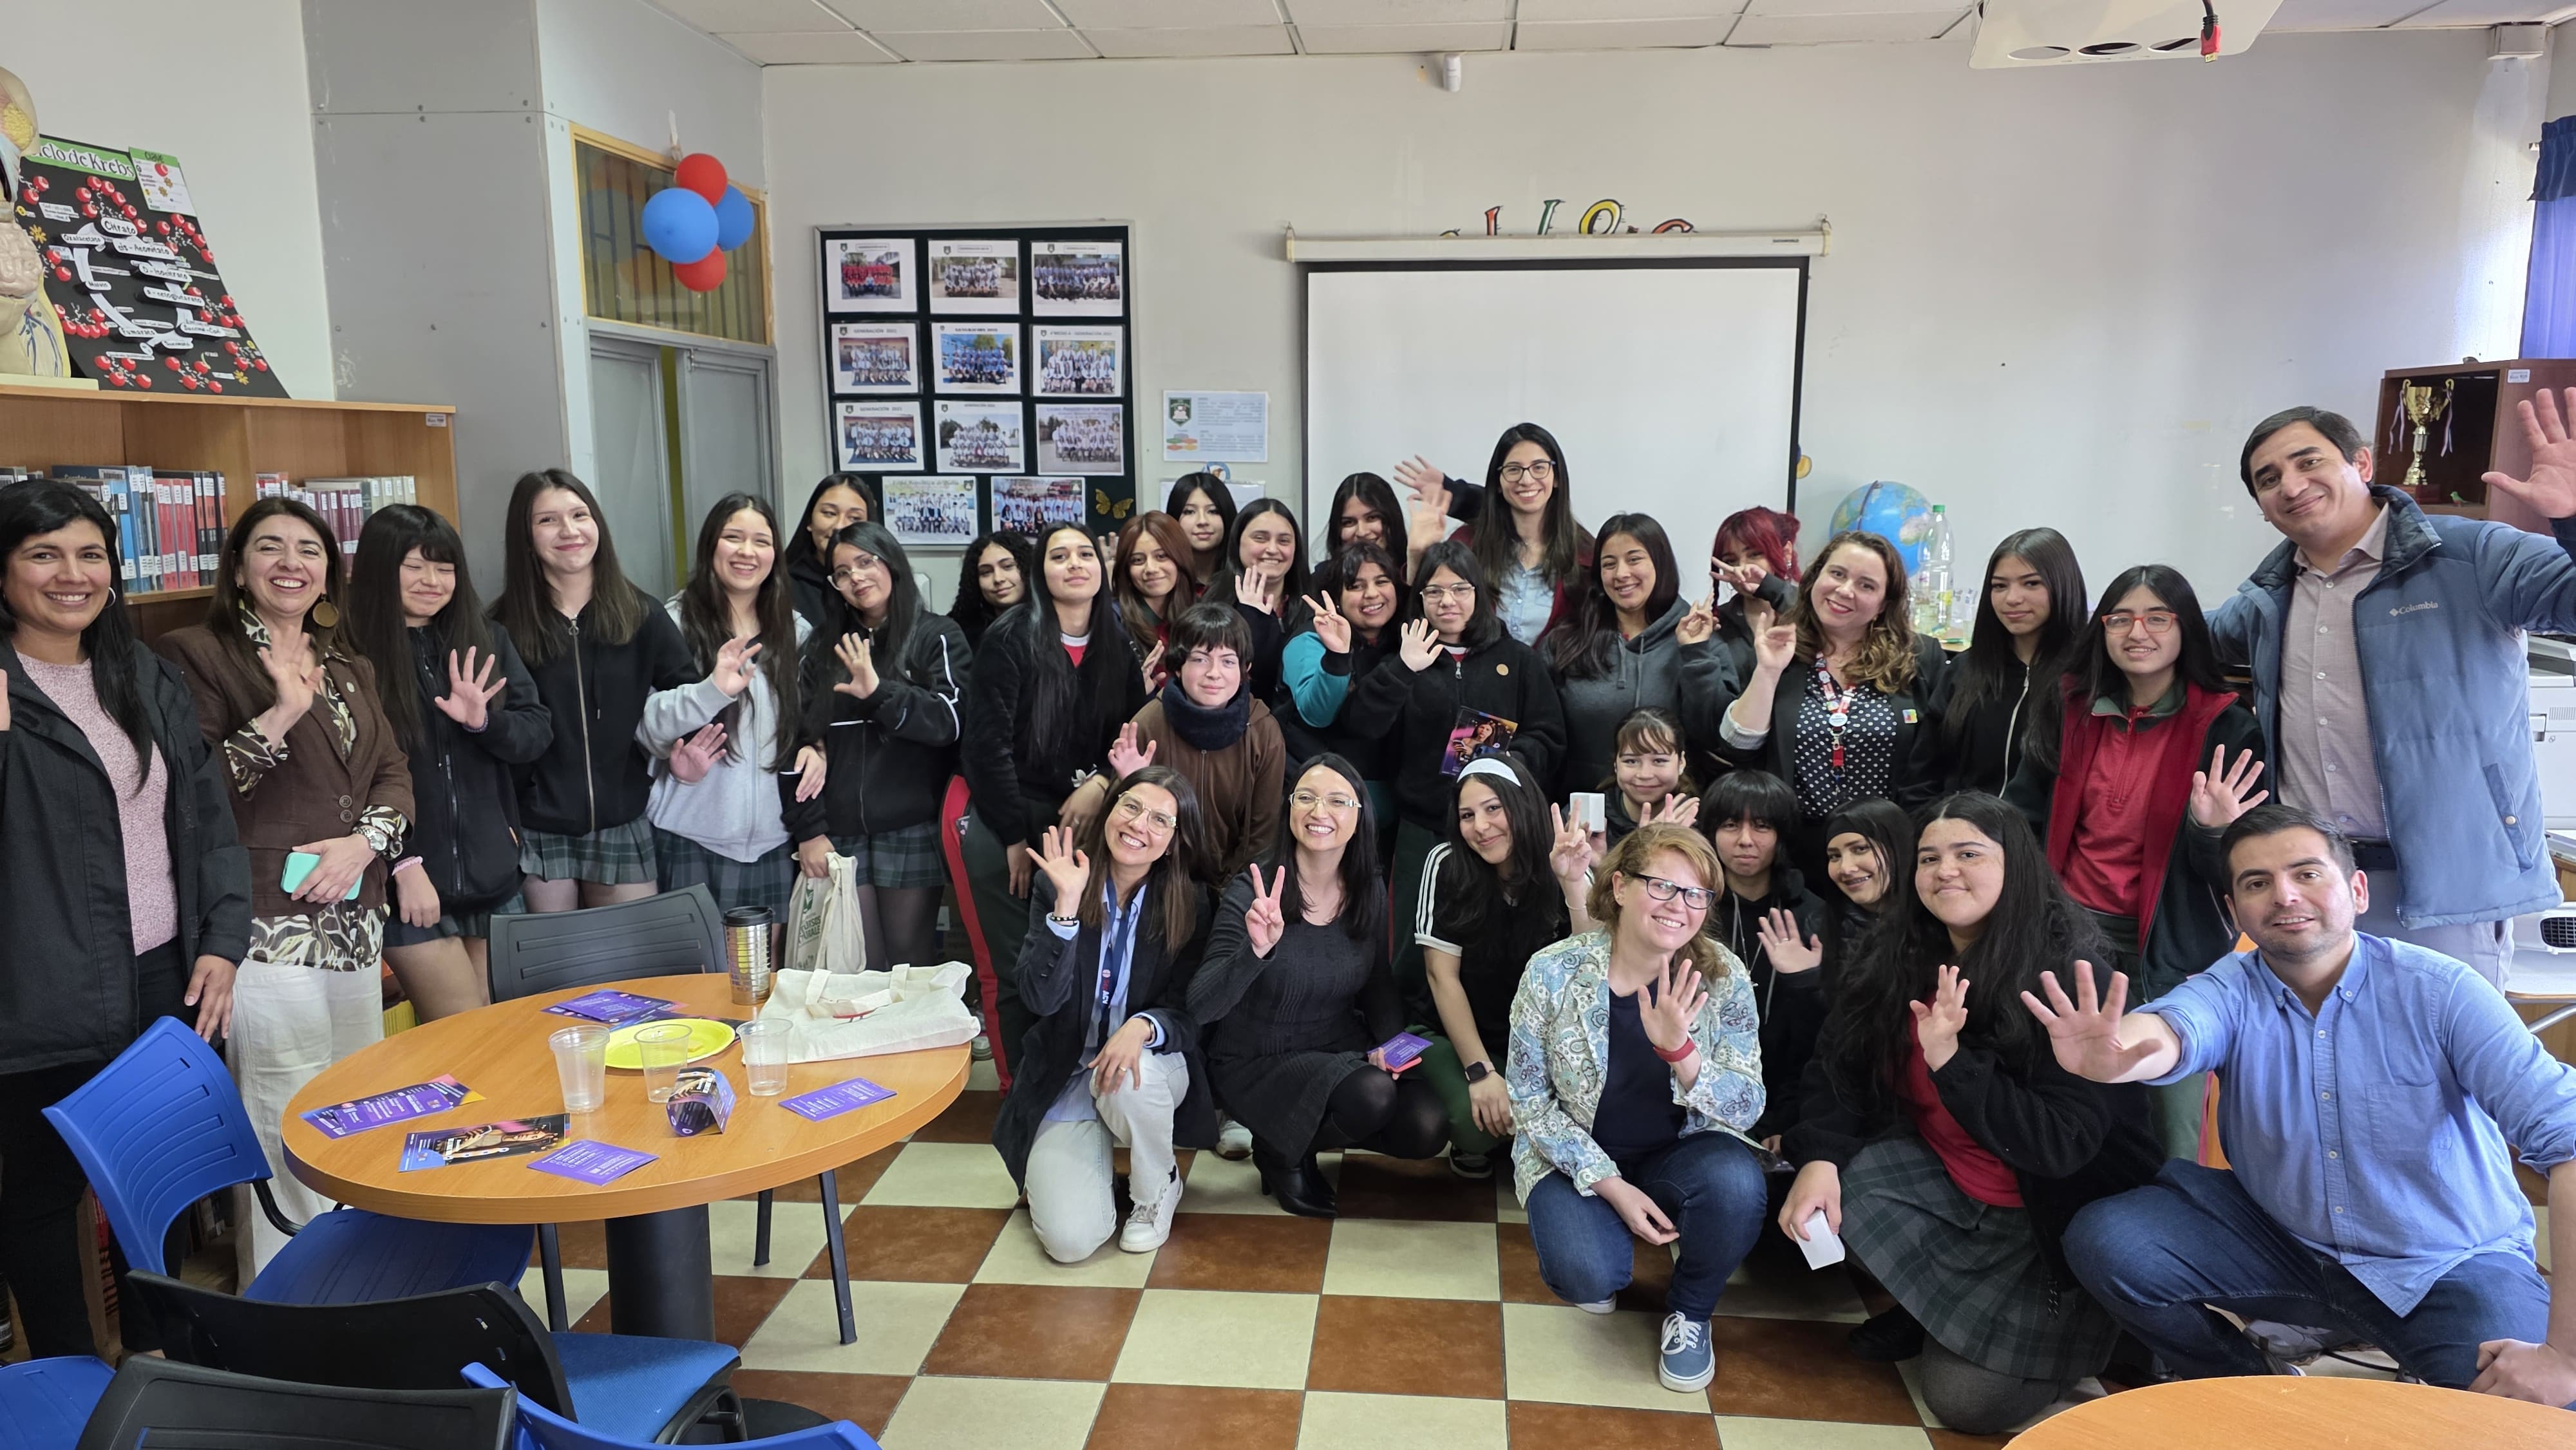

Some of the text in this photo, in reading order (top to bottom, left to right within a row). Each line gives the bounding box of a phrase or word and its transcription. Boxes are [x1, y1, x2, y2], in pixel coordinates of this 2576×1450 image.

[39, 143, 135, 176] clo de Krebs
[104, 221, 137, 235] Citrato
[2398, 601, 2439, 614] Columbia
